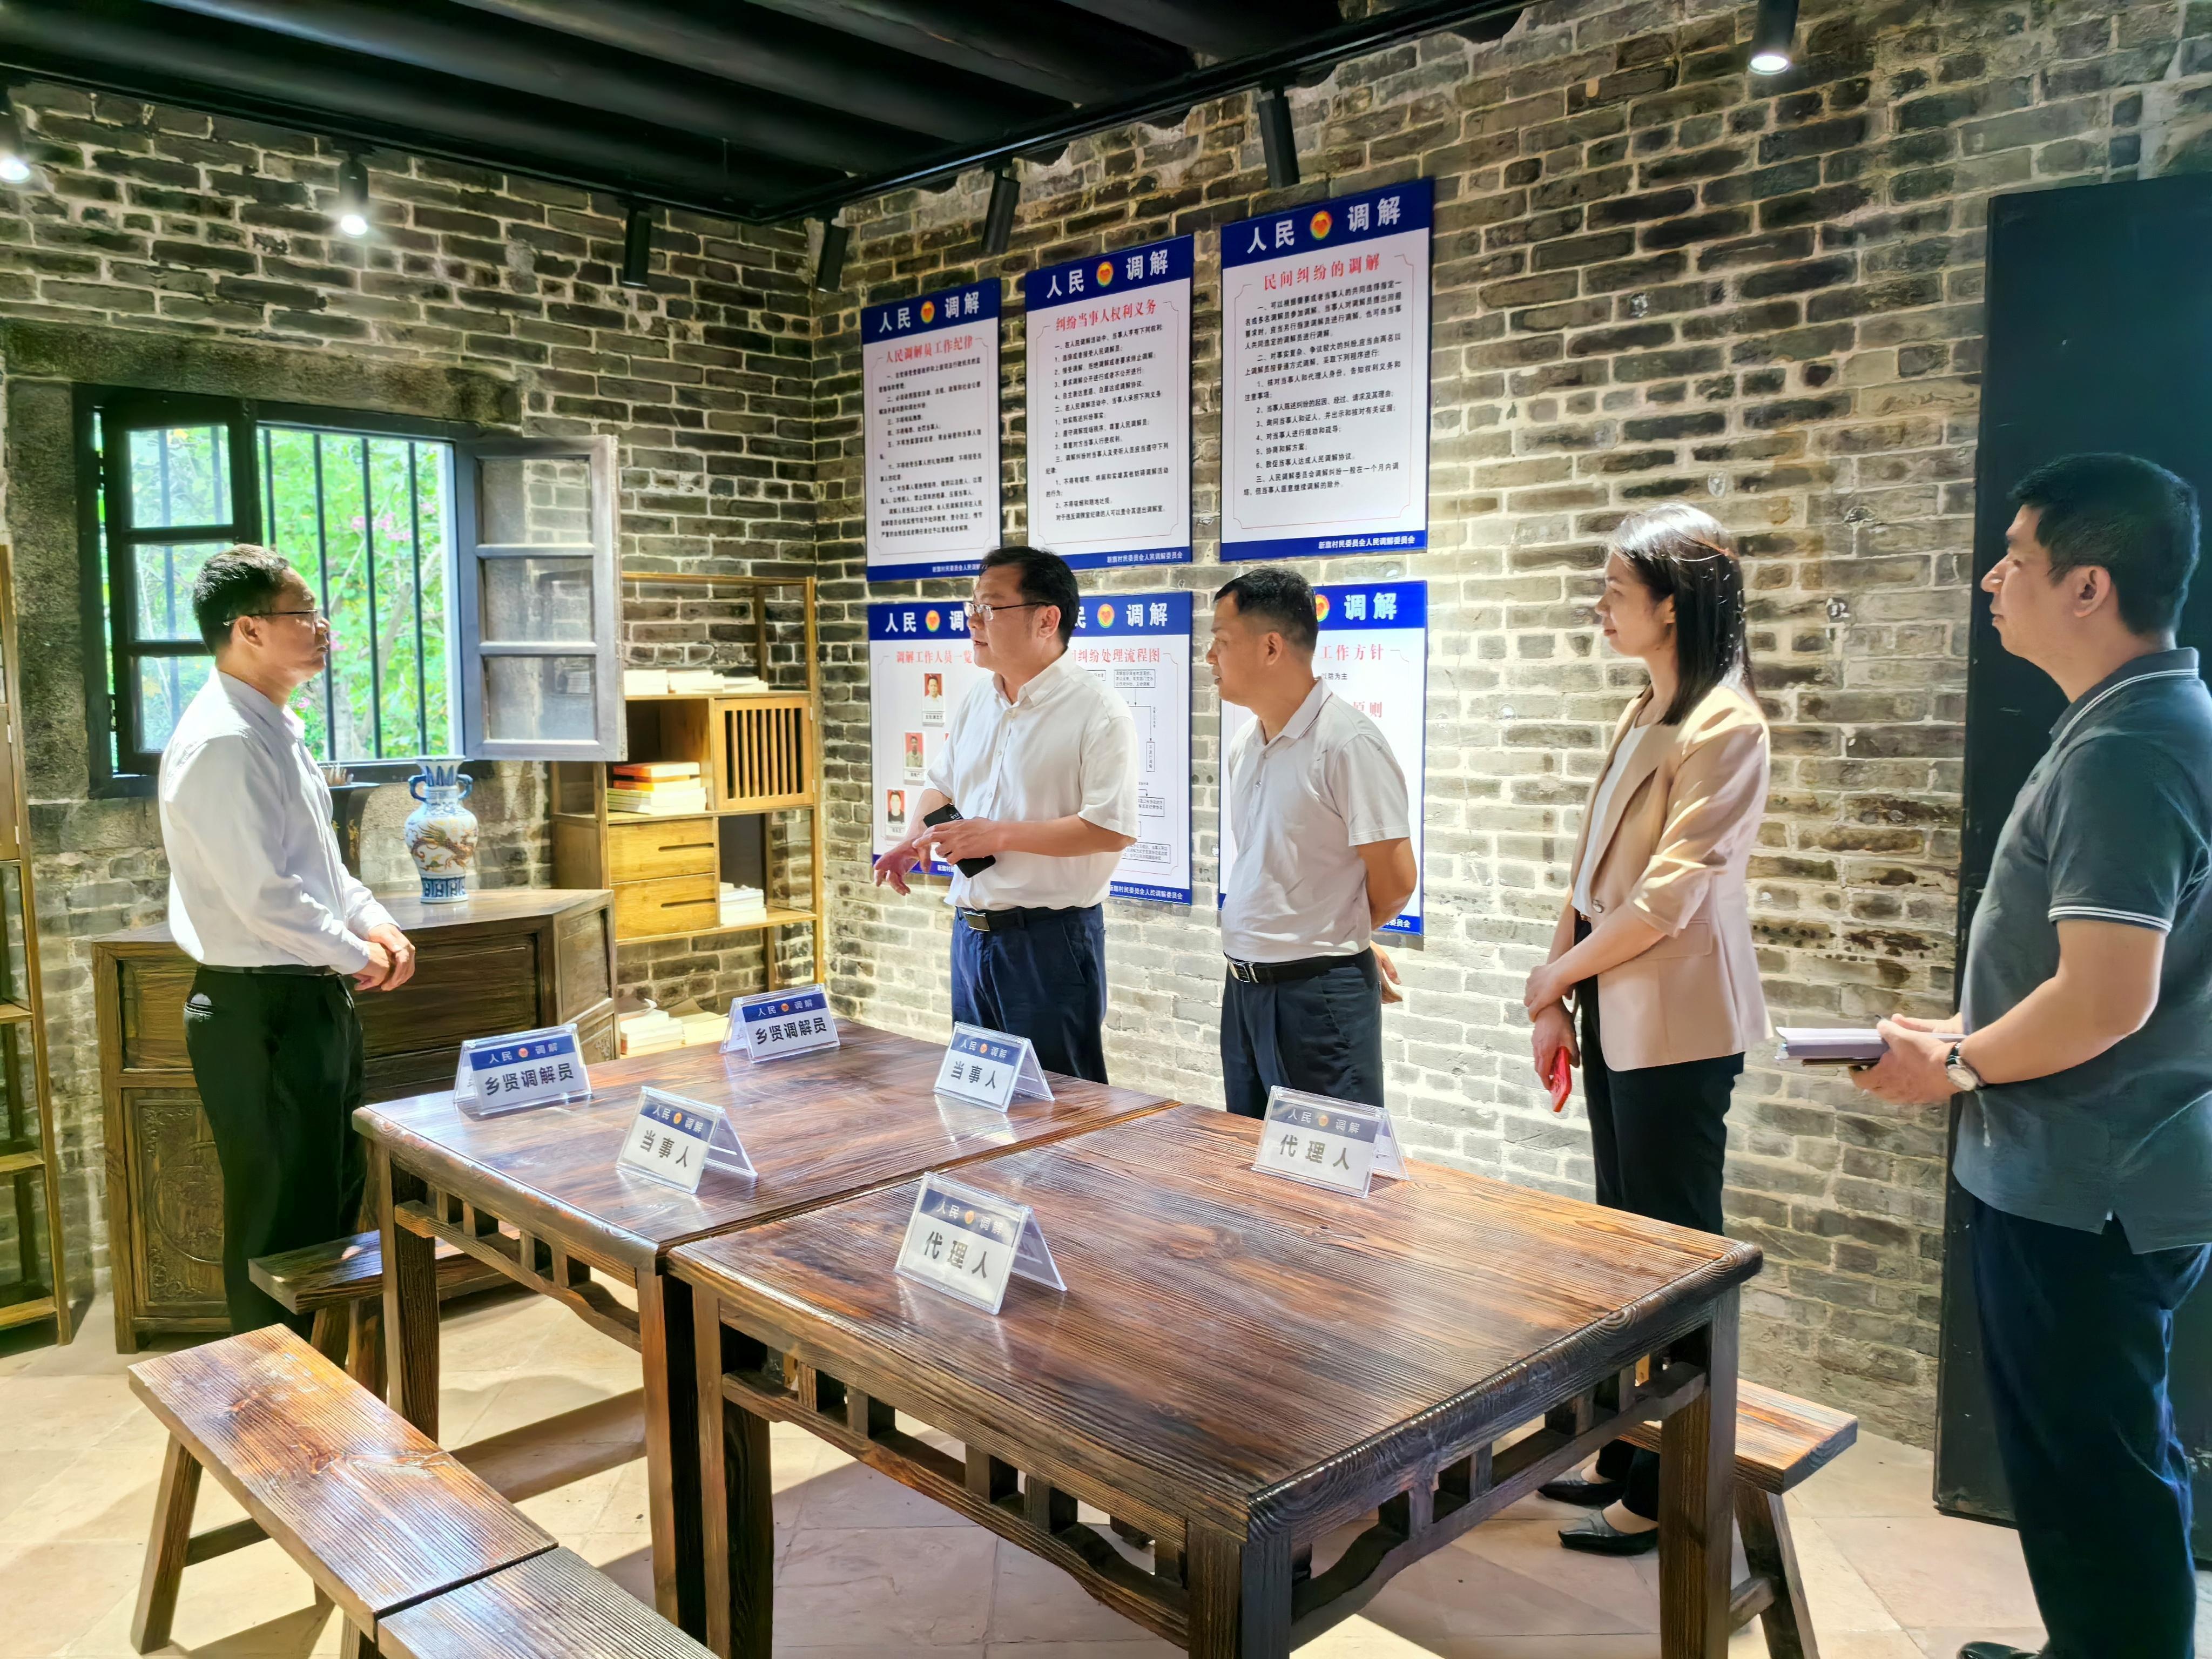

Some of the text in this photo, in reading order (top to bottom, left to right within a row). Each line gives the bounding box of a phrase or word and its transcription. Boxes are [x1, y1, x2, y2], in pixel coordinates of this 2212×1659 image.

[1246, 195, 1401, 254] 人民 调解
[1047, 249, 1168, 299] 人民 调解
[1264, 253, 1380, 291] 民间纠纷的调解
[879, 291, 980, 333] 人民 调解
[1055, 299, 1156, 332] 纠纷当事人权利义务
[886, 335, 973, 363] 人民调解员工作纪律
[1126, 602, 1168, 627] 调解
[1344, 592, 1397, 621] 调解
[885, 610, 964, 633] 人民 调
[896, 649, 973, 664] 调解工作人员一览
[1072, 648, 1160, 663] 纠纷处理流程图
[1313, 643, 1384, 660] 工作方针
[758, 1006, 777, 1016] 人民
[756, 1017, 827, 1045] 乡贤调解员
[960, 1038, 977, 1051] 人民
[489, 1051, 512, 1064] 人民
[485, 1062, 574, 1096] 乡贤调解员
[950, 1060, 996, 1089] 当事人
[652, 1104, 671, 1120] 人民
[1287, 1109, 1312, 1123] 人民
[640, 1129, 689, 1168] 当事人
[1279, 1134, 1350, 1171] 代理人
[937, 1201, 960, 1219] 人民
[925, 1231, 987, 1279] 代理人
